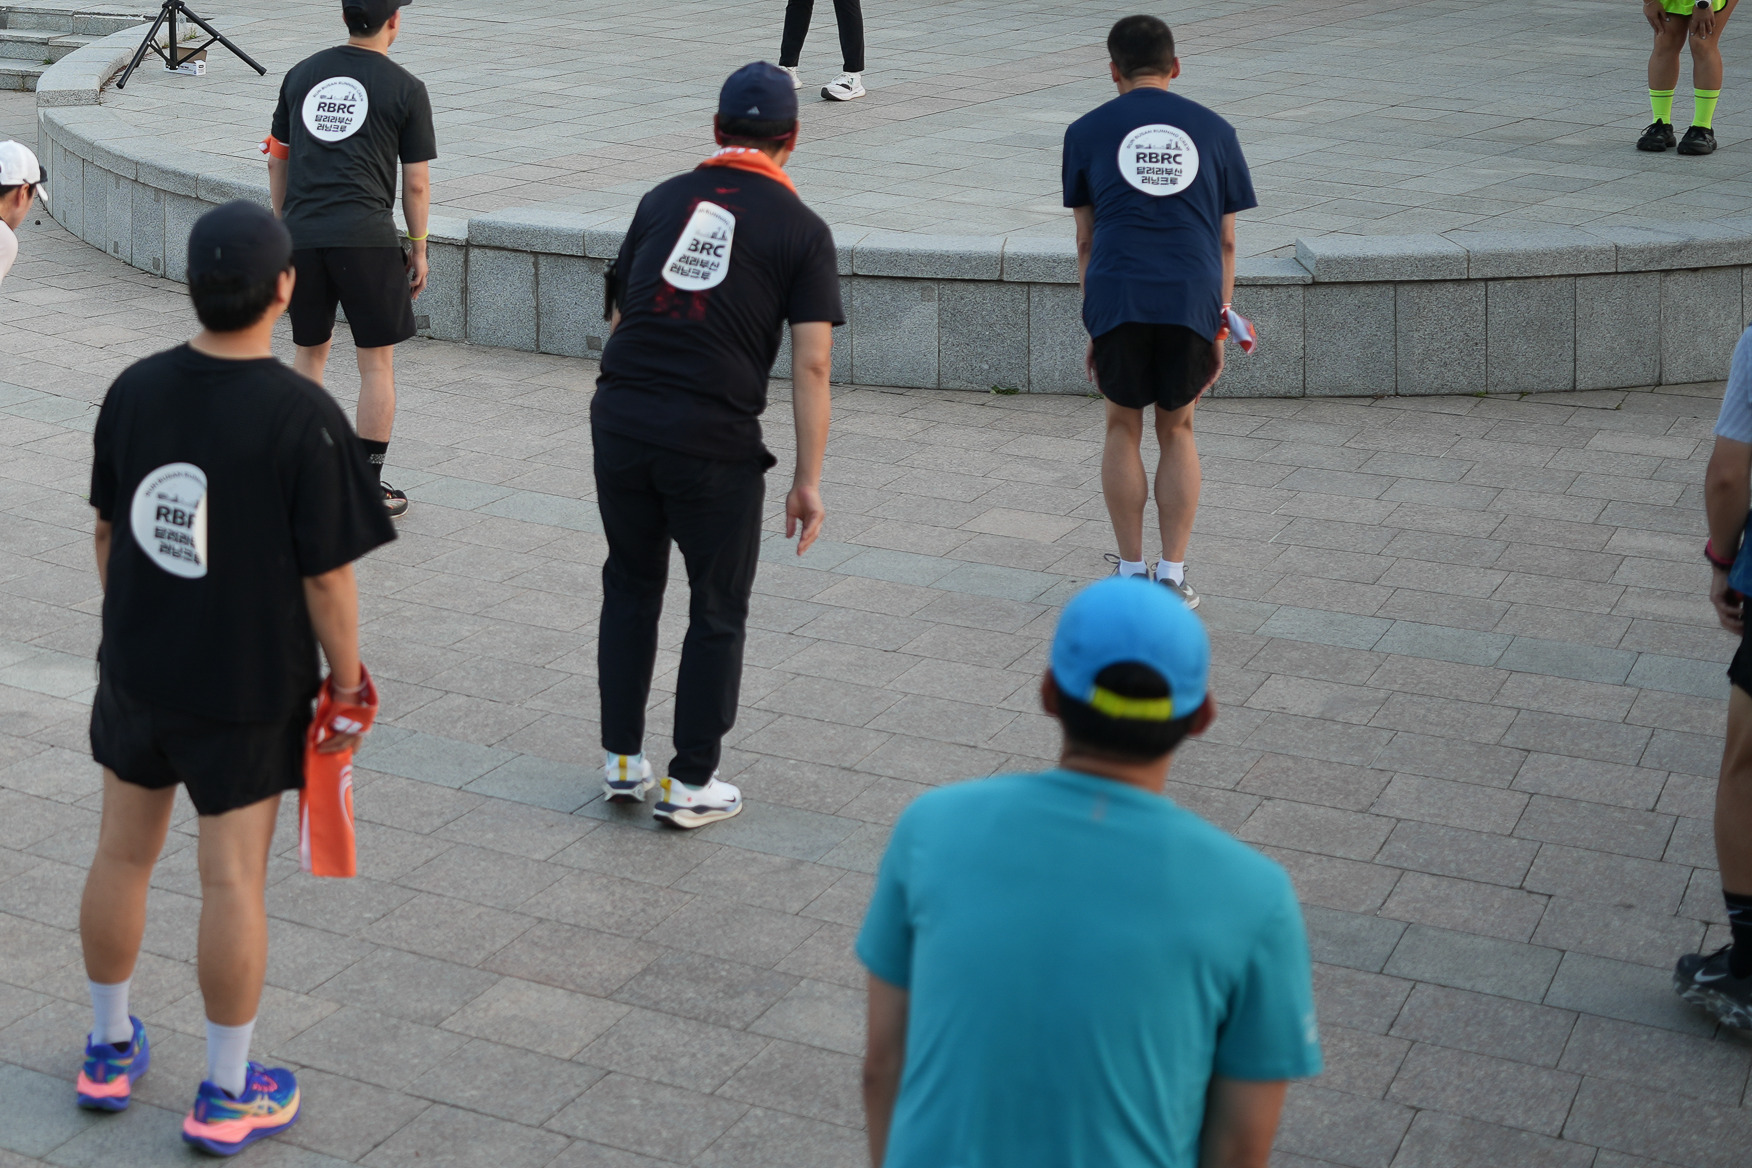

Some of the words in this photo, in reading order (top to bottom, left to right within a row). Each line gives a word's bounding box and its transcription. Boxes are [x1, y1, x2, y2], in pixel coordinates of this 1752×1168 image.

[317, 101, 356, 115] RBRC
[314, 114, 353, 125] 달려라부산
[1153, 129, 1179, 138] RUNNING
[1136, 151, 1183, 165] RBRC
[1136, 166, 1183, 177] 달려라부산
[1141, 175, 1179, 185] 러닝크루
[687, 238, 726, 258] BRC
[678, 254, 720, 272] 려라부산
[156, 505, 196, 529] RB
